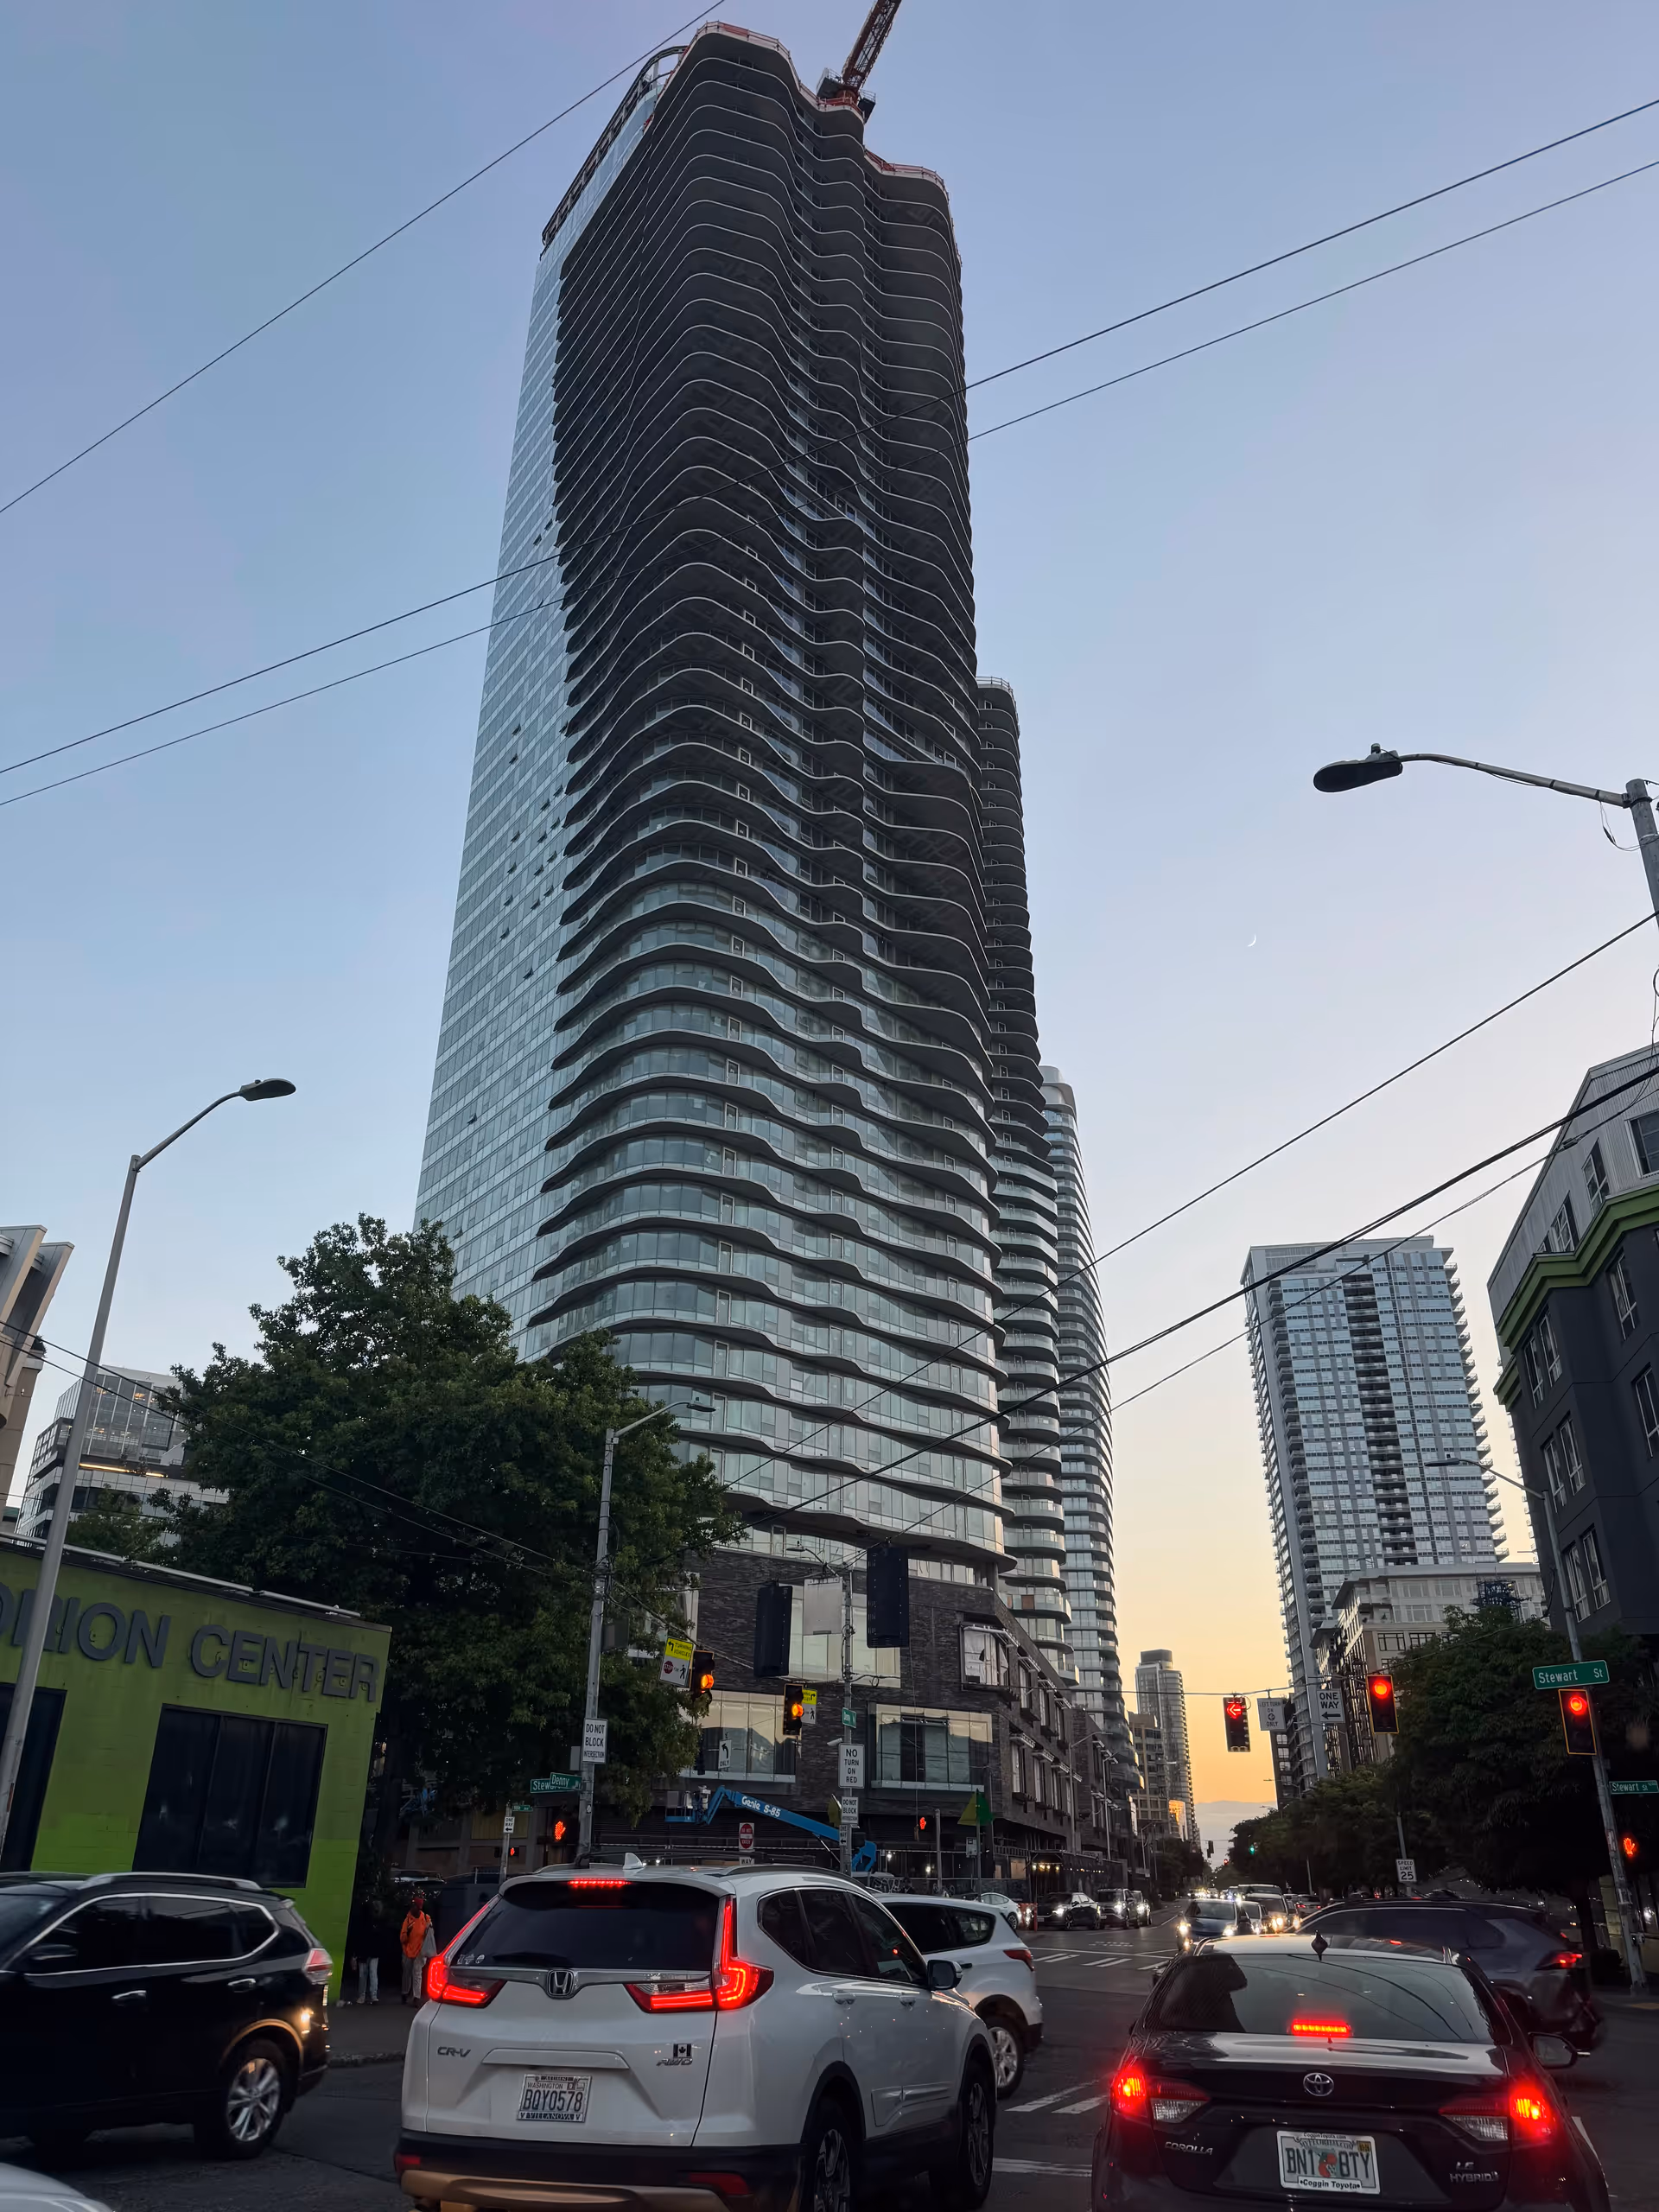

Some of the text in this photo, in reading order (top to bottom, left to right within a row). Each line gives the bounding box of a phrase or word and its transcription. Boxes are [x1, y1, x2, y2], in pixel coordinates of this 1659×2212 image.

[191, 1624, 381, 1702] CENTER
[1538, 1668, 1604, 1684] Stewart St
[1319, 1692, 1338, 1700] ONE
[586, 1724, 605, 1733] DO NOT
[585, 1737, 604, 1747] BLOCK
[846, 1748, 858, 1758] NO
[532, 1781, 561, 1791] Stew
[551, 1774, 570, 1788] Denny
[1611, 1782, 1640, 1792] Stewart
[741, 1796, 781, 1818] Genie S-85
[1401, 1871, 1414, 1880] 25
[437, 2046, 472, 2057] CR-V
[523, 2088, 584, 2113] BQY0578
[1165, 2141, 1214, 2156] COROLLA
[1449, 2172, 1493, 2183] HYBRID
[1303, 2178, 1357, 2190] Coggin Toyota
